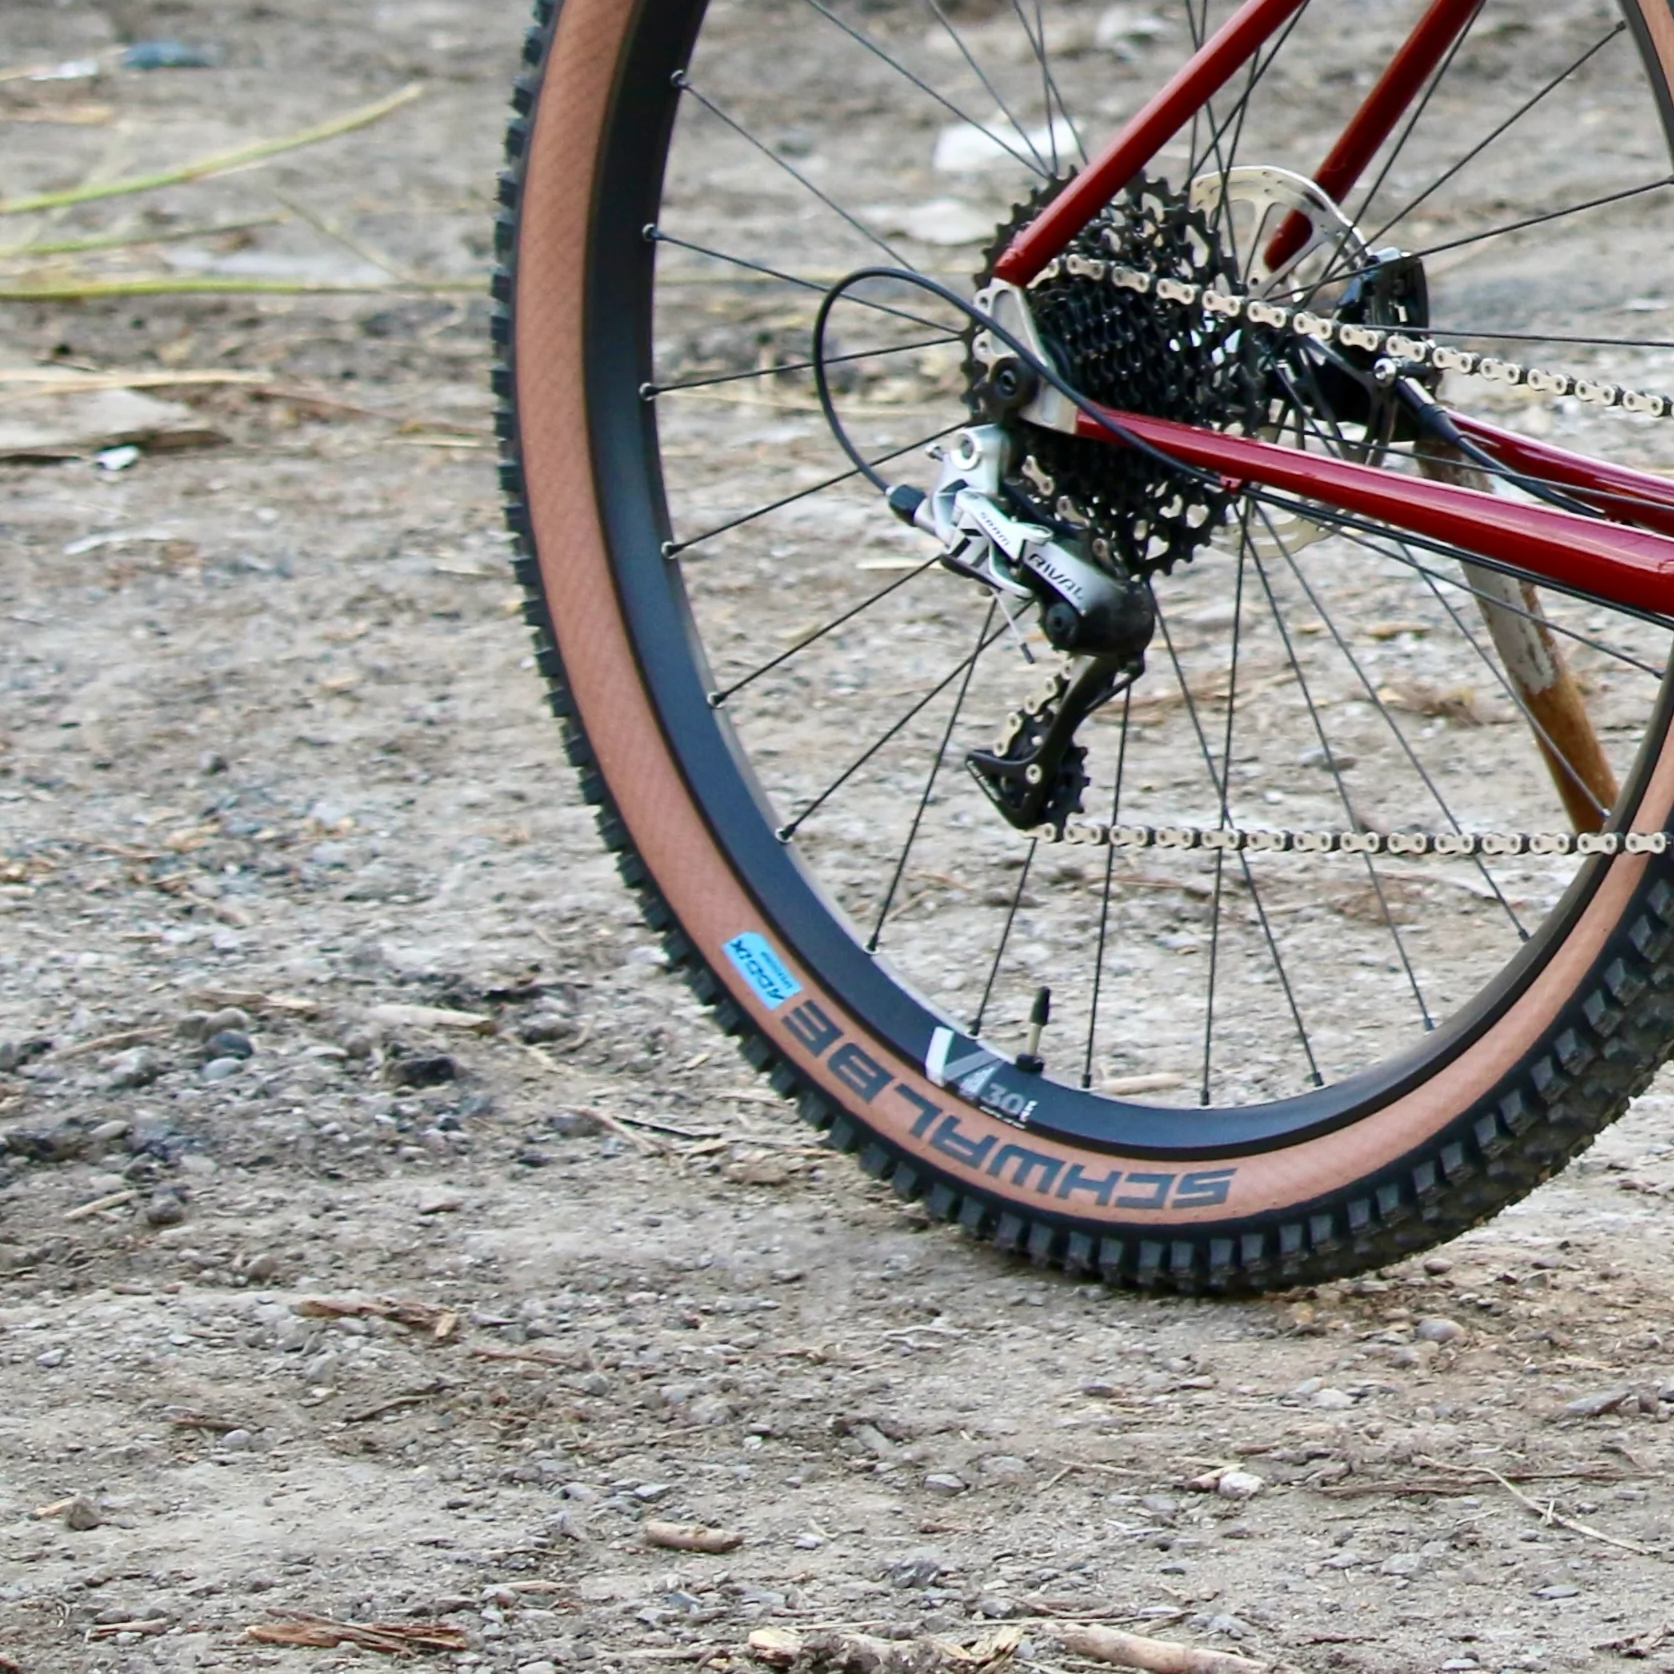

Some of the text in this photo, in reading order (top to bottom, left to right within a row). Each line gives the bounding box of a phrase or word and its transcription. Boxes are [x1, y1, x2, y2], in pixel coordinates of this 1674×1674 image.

[1028, 553, 1086, 601] RIVAL
[781, 998, 1238, 1211] SCHWALBE
[979, 1082, 1024, 1116] 30
